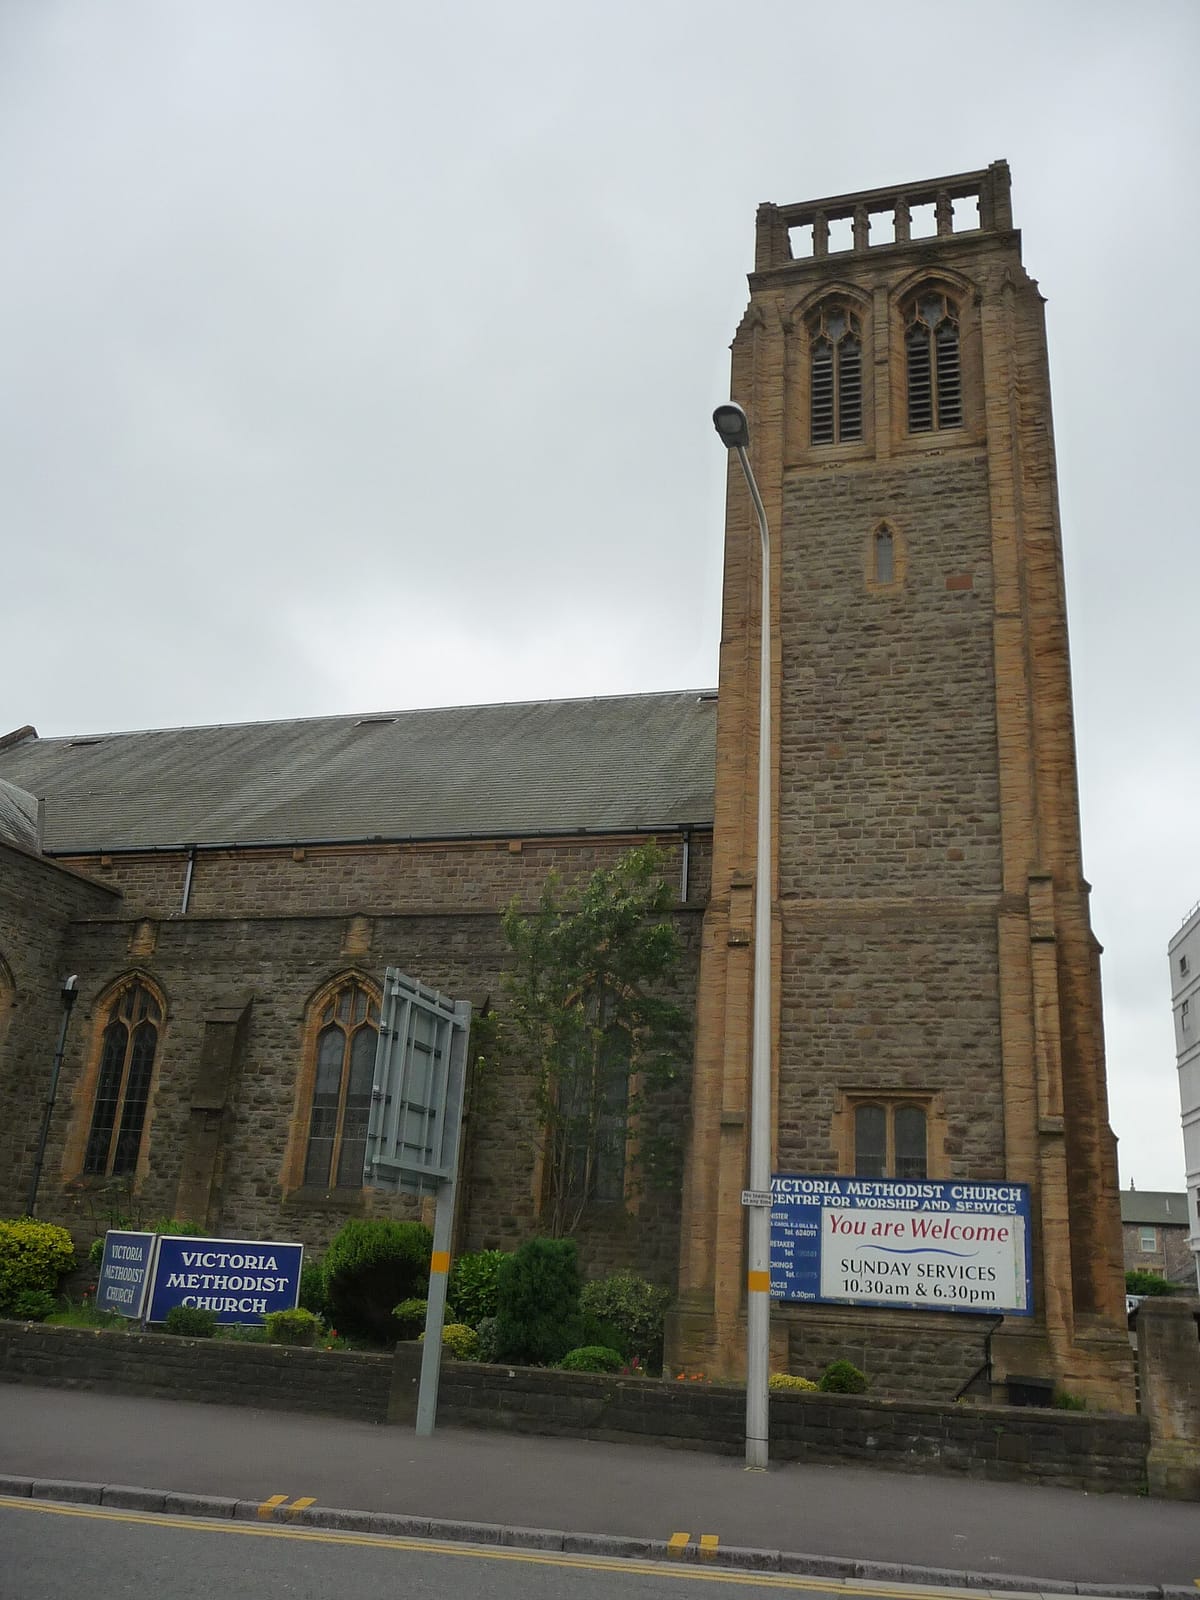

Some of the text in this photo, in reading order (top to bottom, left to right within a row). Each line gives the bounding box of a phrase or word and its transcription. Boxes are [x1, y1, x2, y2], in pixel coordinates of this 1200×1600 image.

[847, 1182, 944, 1199] METHODIST
[951, 1185, 1022, 1202] CHURCH
[823, 1196, 851, 1207] FOR
[855, 1197, 919, 1210] WORSHIP
[921, 1200, 951, 1212] AND
[956, 1201, 1017, 1214] SERVICE
[829, 1214, 1009, 1242] You are Welcome
[112, 1245, 143, 1261] VICTORIA
[181, 1252, 278, 1270] VICTORIA
[104, 1264, 145, 1284] METHODIST
[841, 1259, 996, 1281] SUNDAY SERVICES
[166, 1273, 289, 1292] METHODIST
[843, 1279, 996, 1303] 10.30am & 6.30pm
[106, 1286, 134, 1304] CHURCH
[181, 1295, 268, 1313] CHURCH
